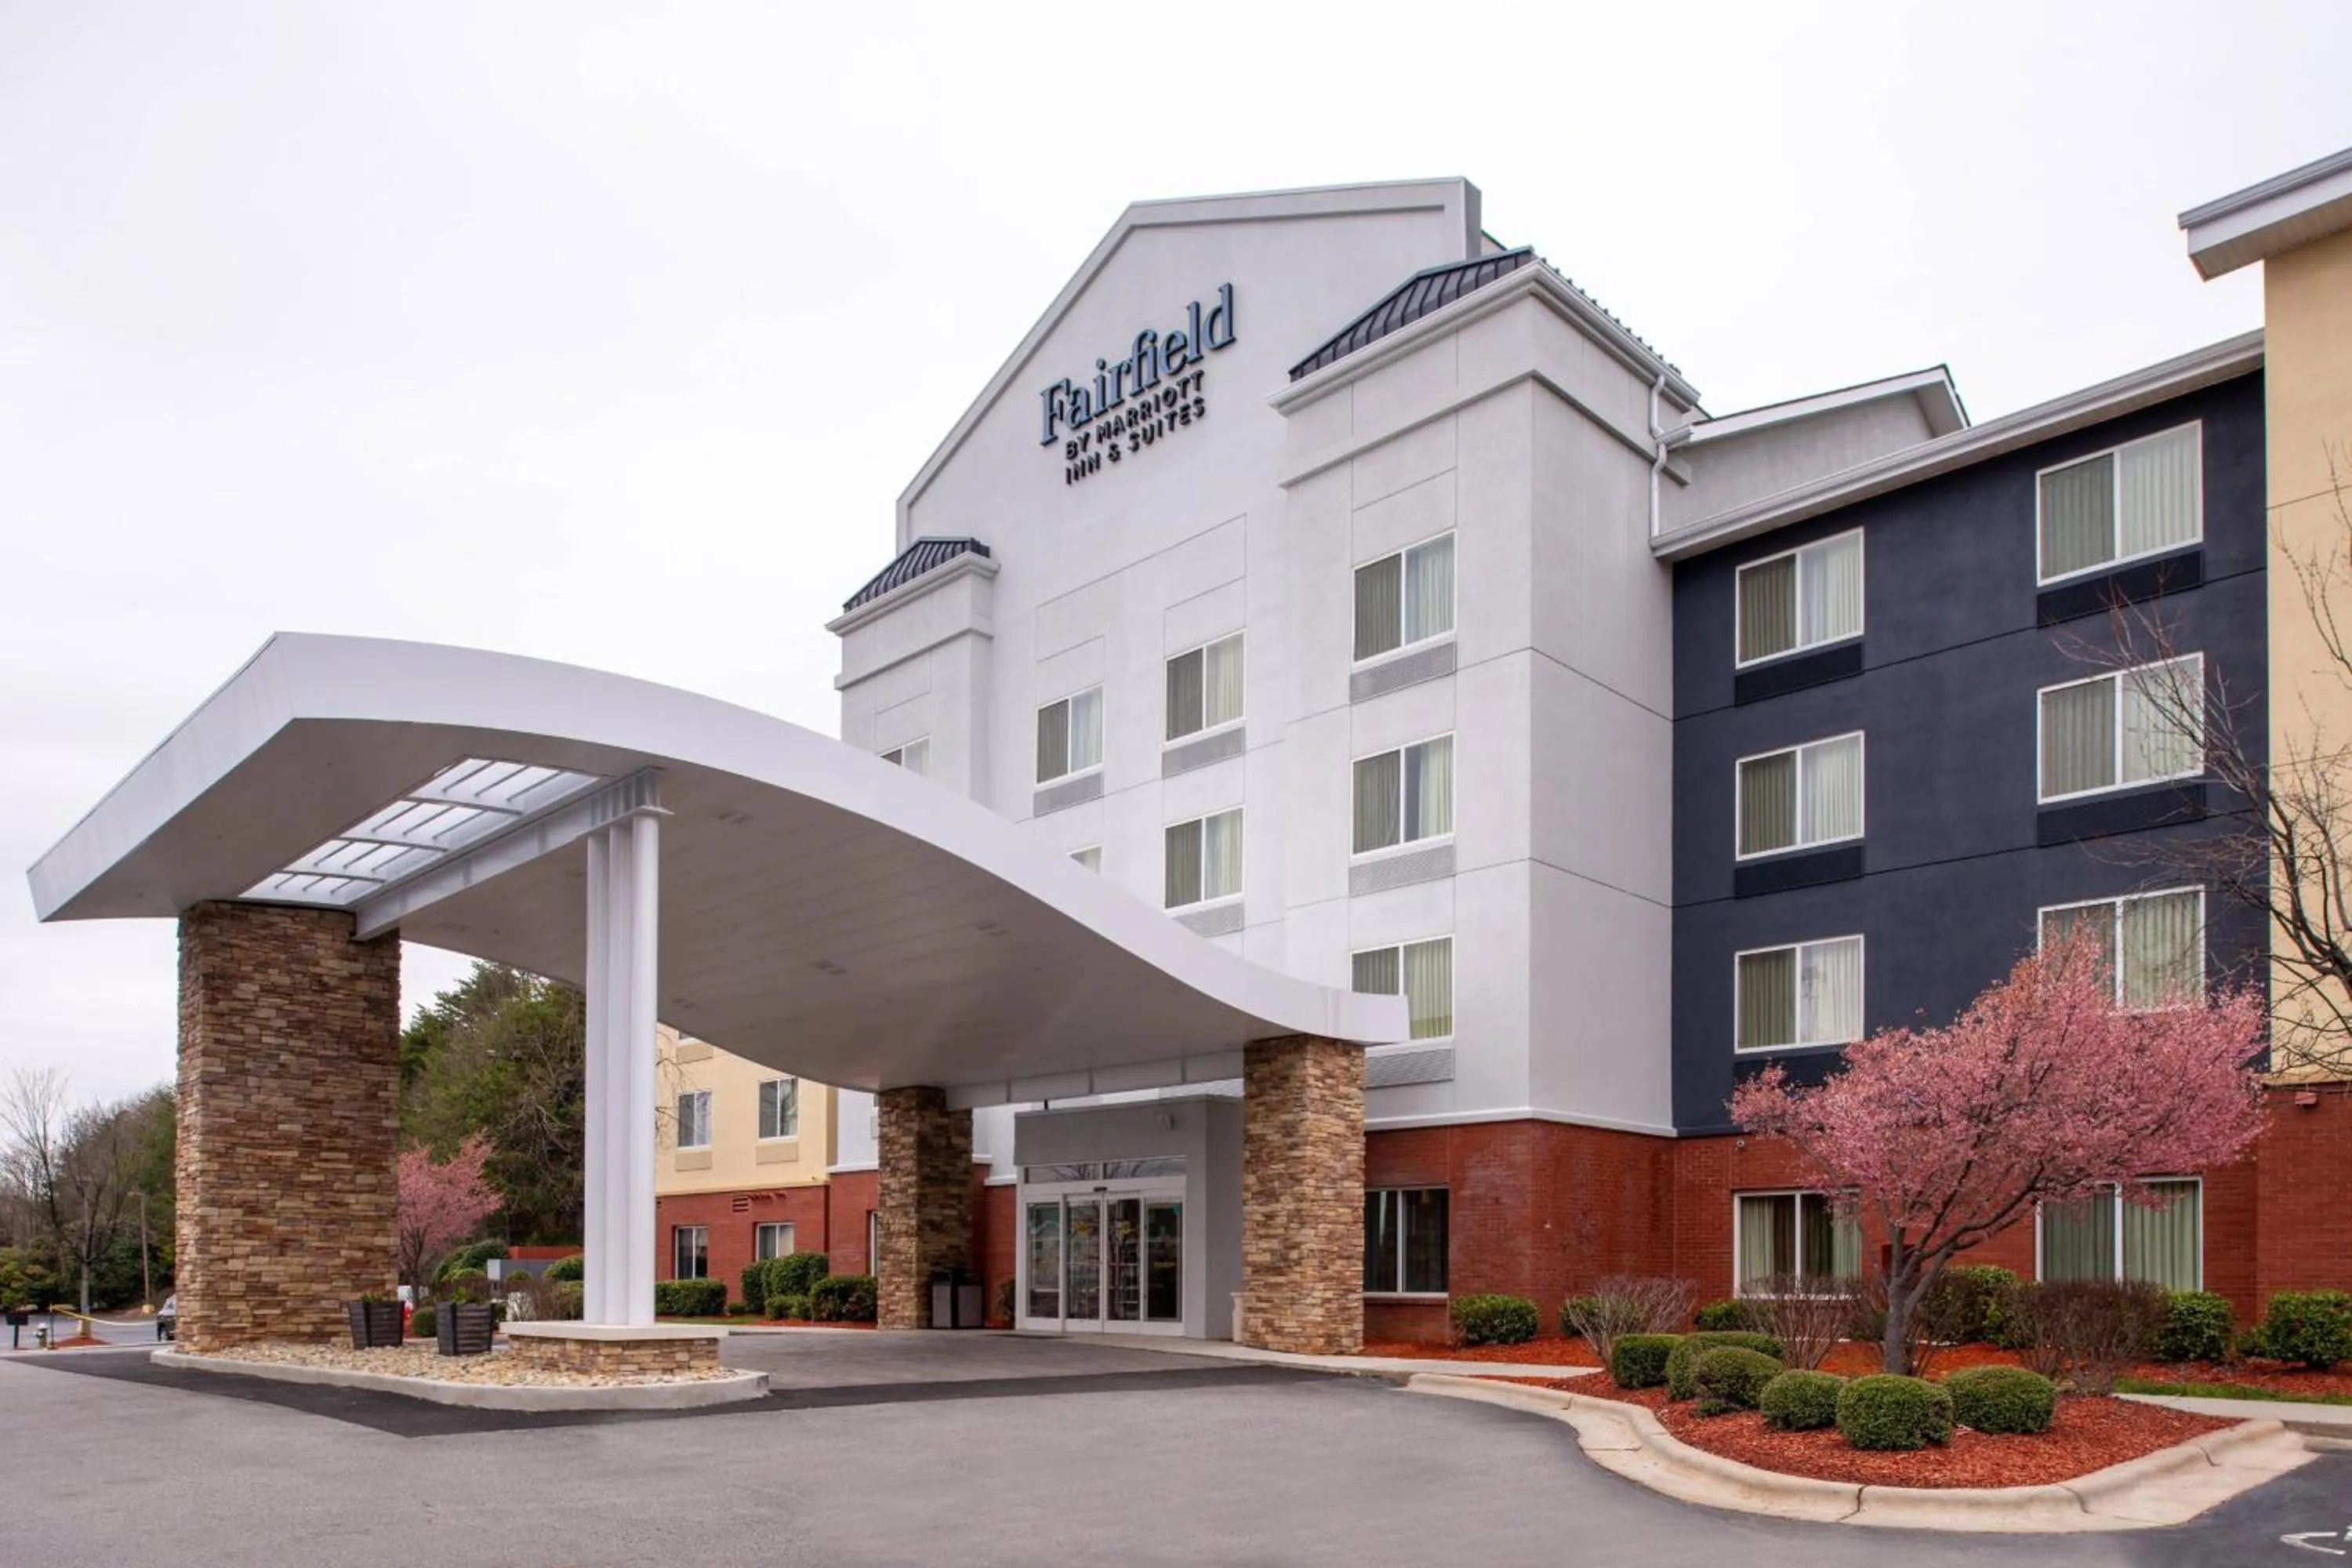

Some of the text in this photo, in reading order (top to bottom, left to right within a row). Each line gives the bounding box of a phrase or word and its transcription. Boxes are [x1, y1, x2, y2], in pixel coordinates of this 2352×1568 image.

[1040, 281, 1236, 446] Fairfield
[1065, 369, 1205, 460] BY MARRIOTT
[1065, 396, 1206, 485] INN & SUITES
